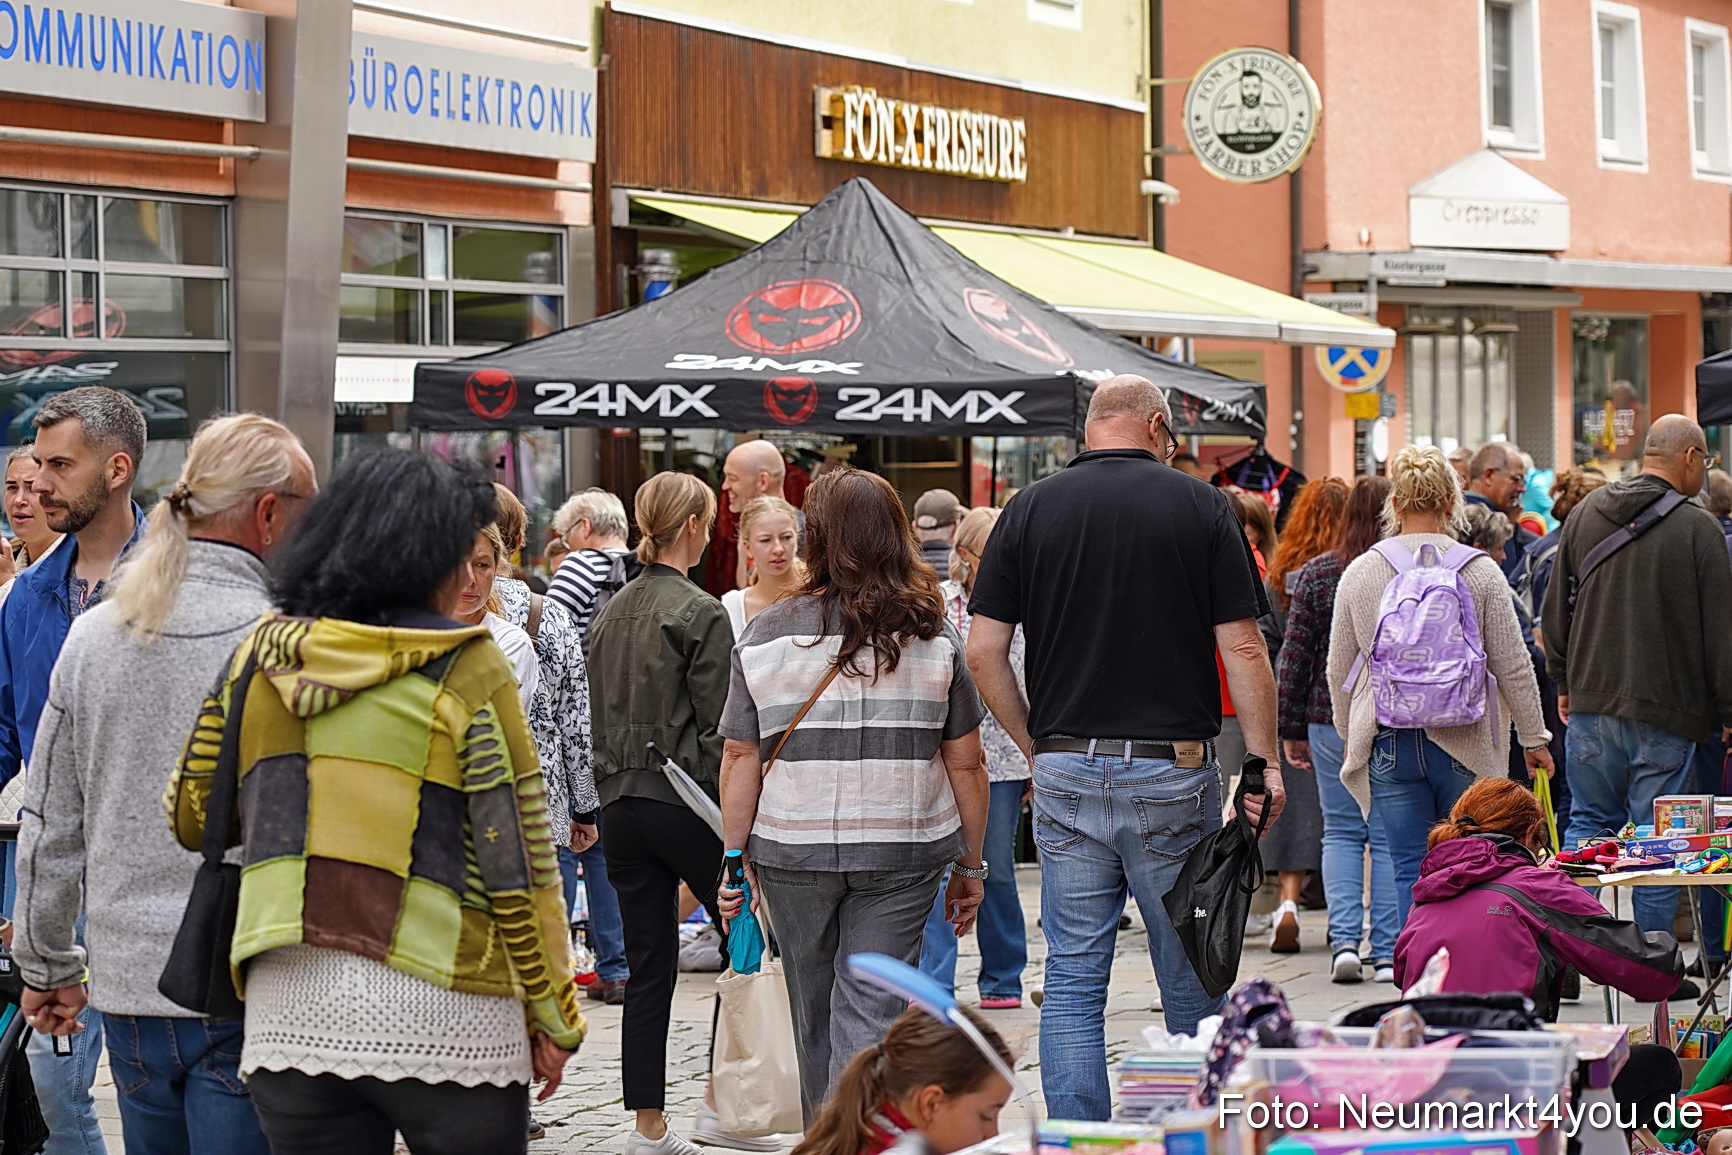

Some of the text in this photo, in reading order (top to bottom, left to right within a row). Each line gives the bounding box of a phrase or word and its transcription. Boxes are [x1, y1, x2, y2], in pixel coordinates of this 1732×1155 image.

[664, 353, 864, 376] 24MX
[533, 382, 720, 418] 24MX
[835, 387, 1029, 424] 24MX
